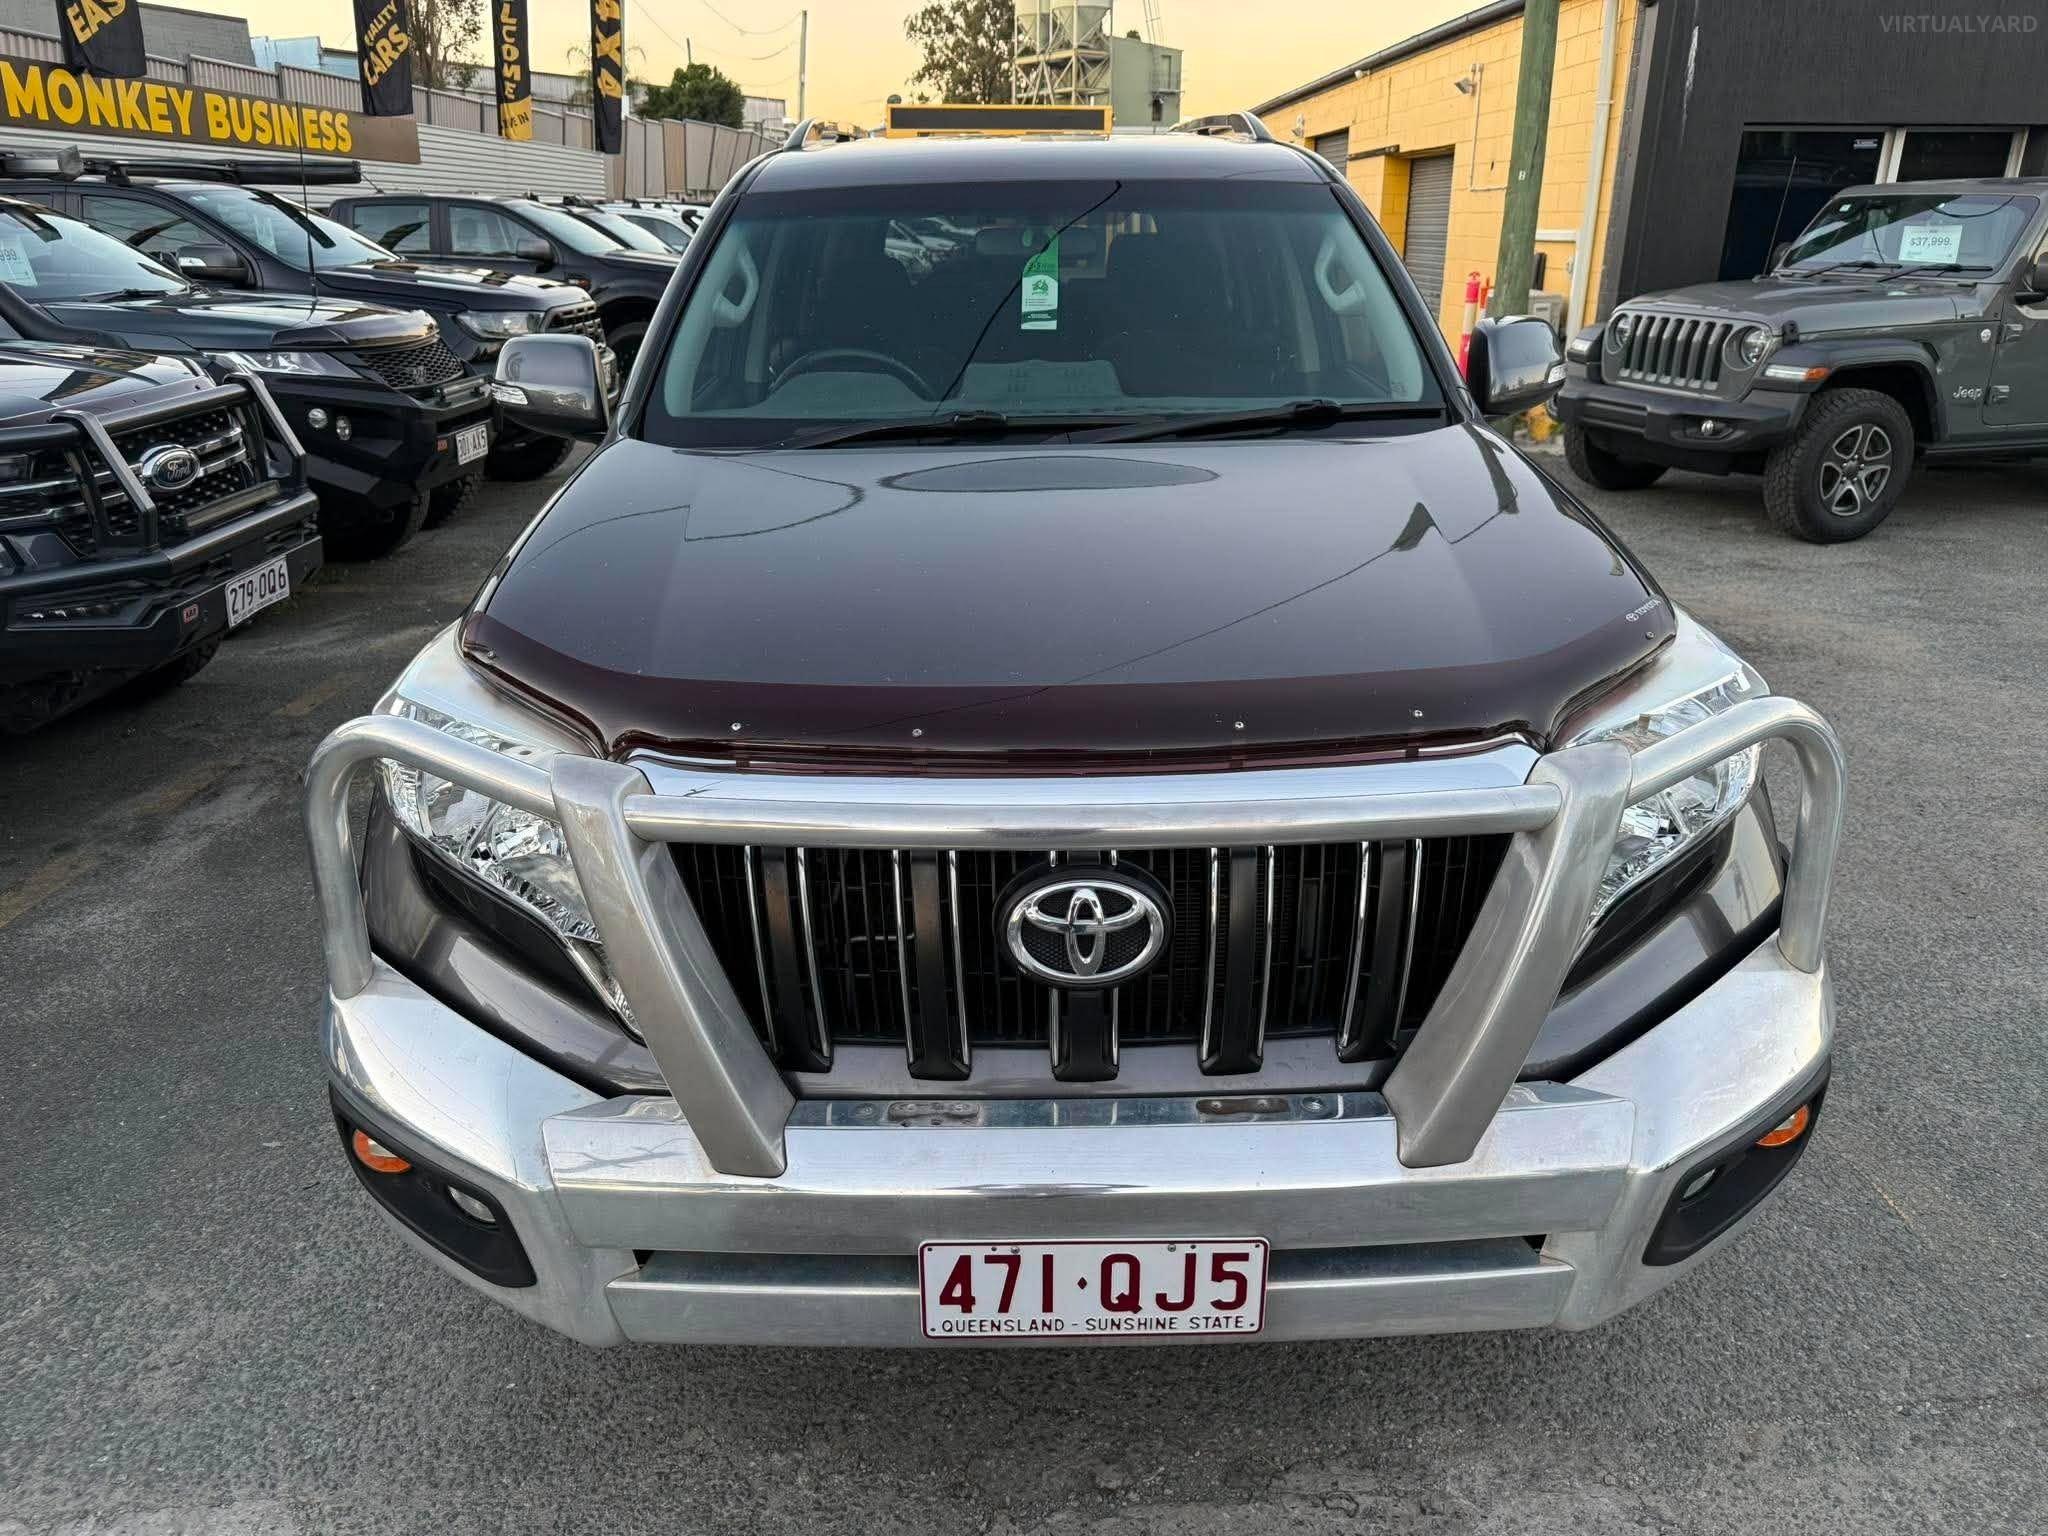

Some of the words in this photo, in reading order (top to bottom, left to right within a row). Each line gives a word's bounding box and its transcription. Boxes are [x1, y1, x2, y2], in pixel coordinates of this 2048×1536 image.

[363, 23, 409, 86] CARS
[0, 61, 193, 136] MONKEY
[204, 92, 353, 153] BUSINESS
[1953, 386, 1983, 400] Jeep
[941, 1318, 1065, 1332] QUEENSLAND
[1086, 1317, 1178, 1331] SUNSHINE
[1189, 1316, 1245, 1329] STATE
